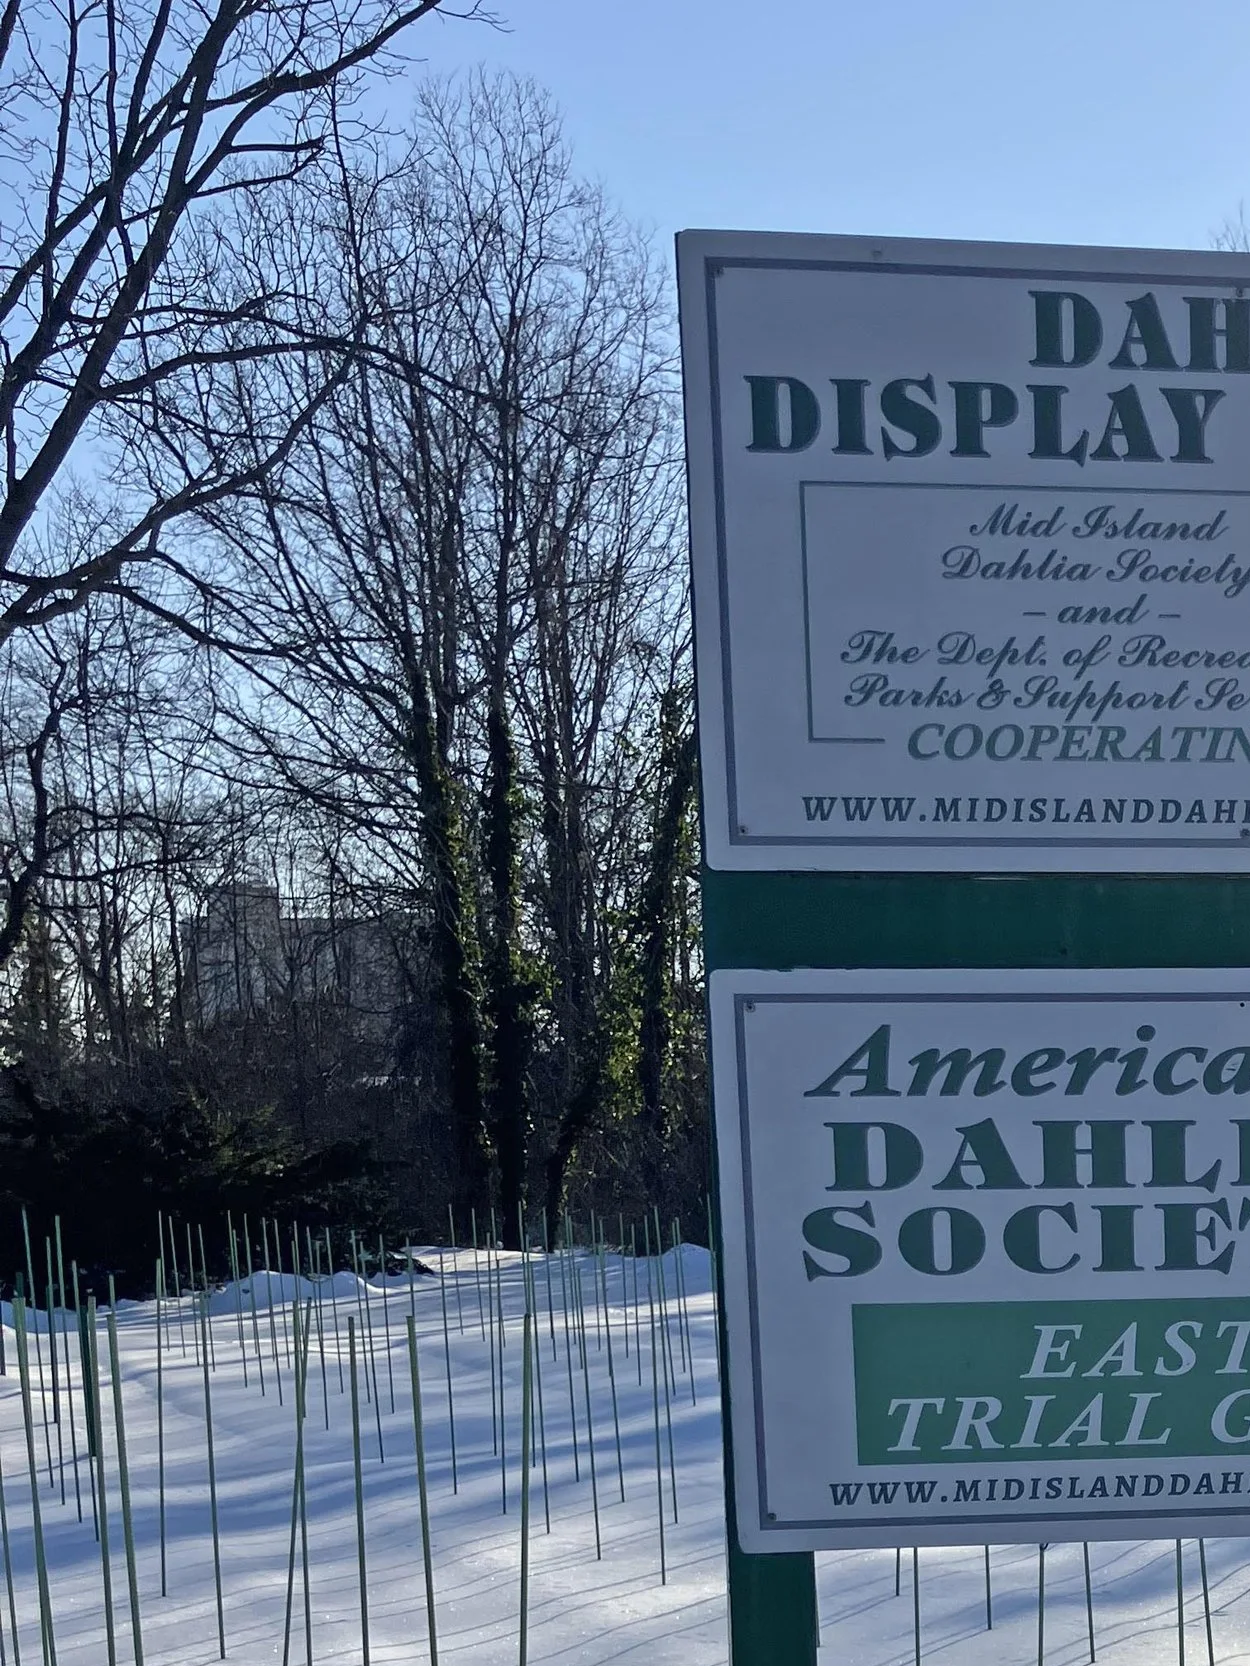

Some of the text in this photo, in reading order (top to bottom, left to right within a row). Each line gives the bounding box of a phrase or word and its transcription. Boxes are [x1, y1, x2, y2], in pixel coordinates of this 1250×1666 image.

[743, 373, 1228, 467] DISPLAY
[969, 503, 1229, 541] Mid Island
[942, 545, 1102, 581] Dahlia
[1058, 594, 1149, 625] and
[840, 630, 930, 664] The
[937, 631, 1048, 679] Dept.
[1063, 635, 1113, 680] of
[844, 673, 975, 708] Parks
[976, 677, 1009, 711] &
[1013, 675, 1191, 722] Support
[887, 1393, 1171, 1452] TRIAL
